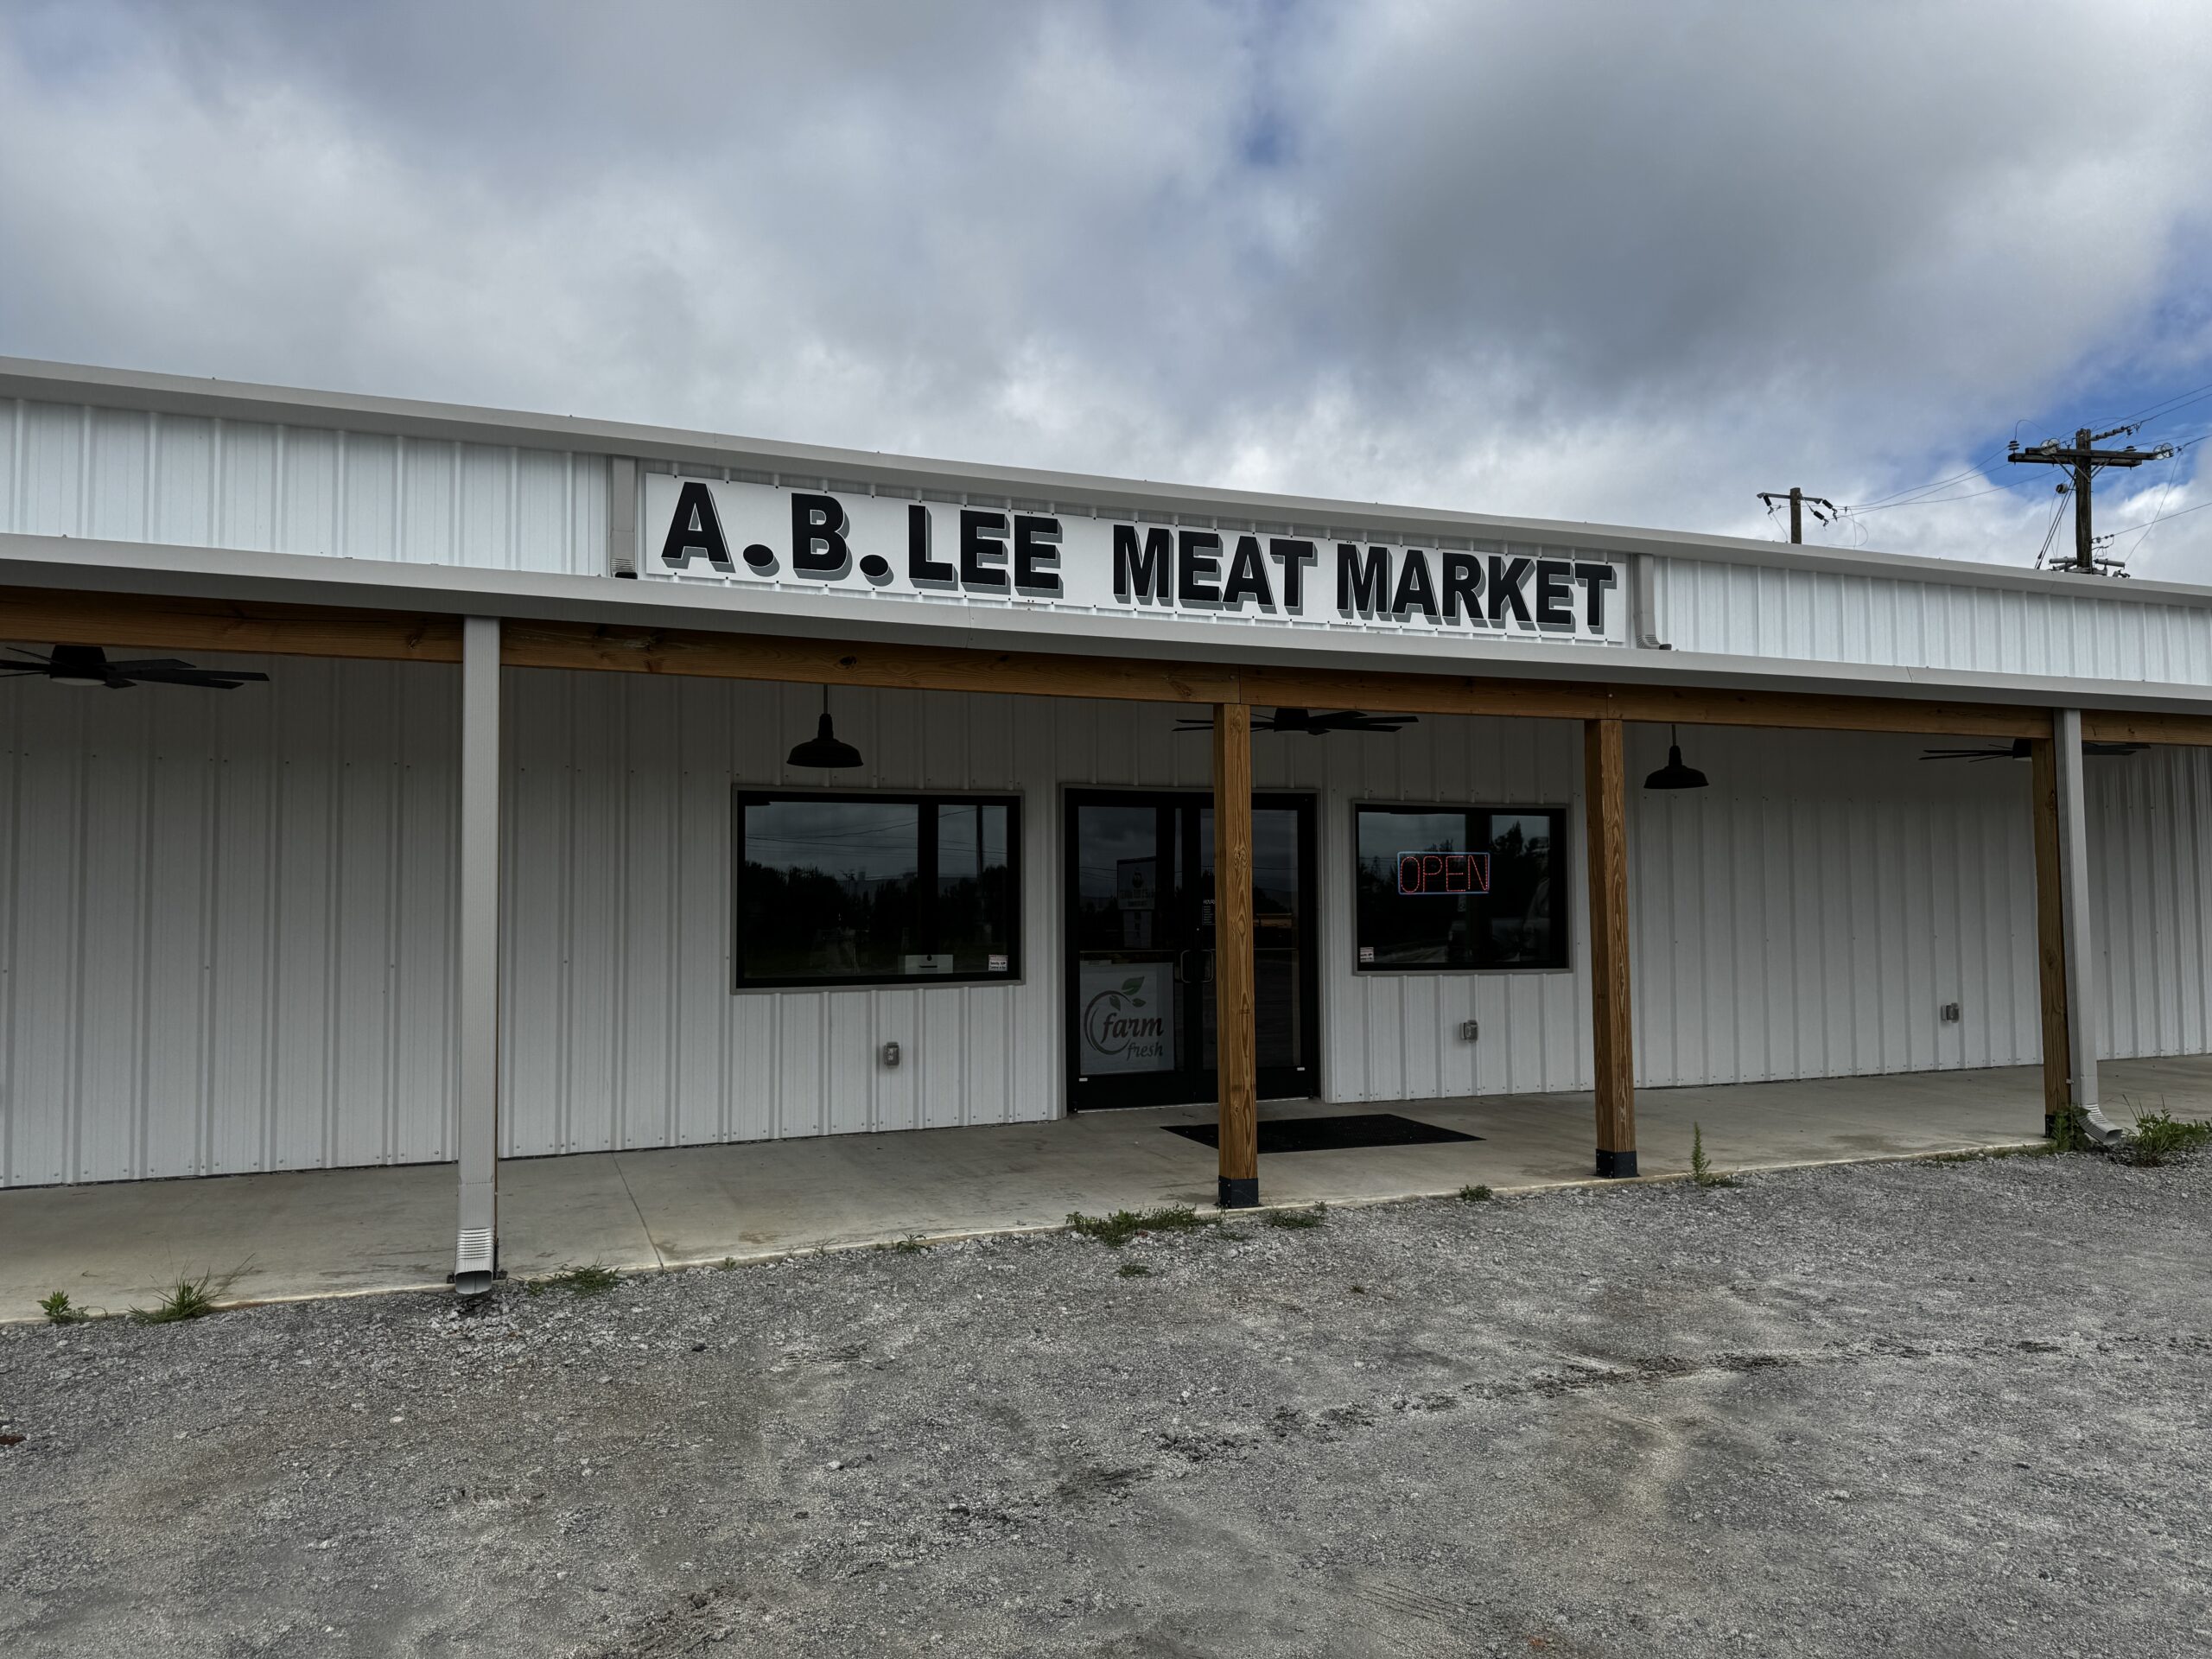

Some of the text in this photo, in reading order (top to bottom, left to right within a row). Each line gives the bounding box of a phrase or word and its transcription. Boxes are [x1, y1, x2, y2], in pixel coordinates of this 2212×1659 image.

[1113, 524, 1318, 615] MEAT
[1336, 543, 1617, 634] MARKET
[1400, 855, 1489, 893] OPEN
[1102, 1013, 1164, 1044] farm
[1127, 1042, 1163, 1061] fresh
